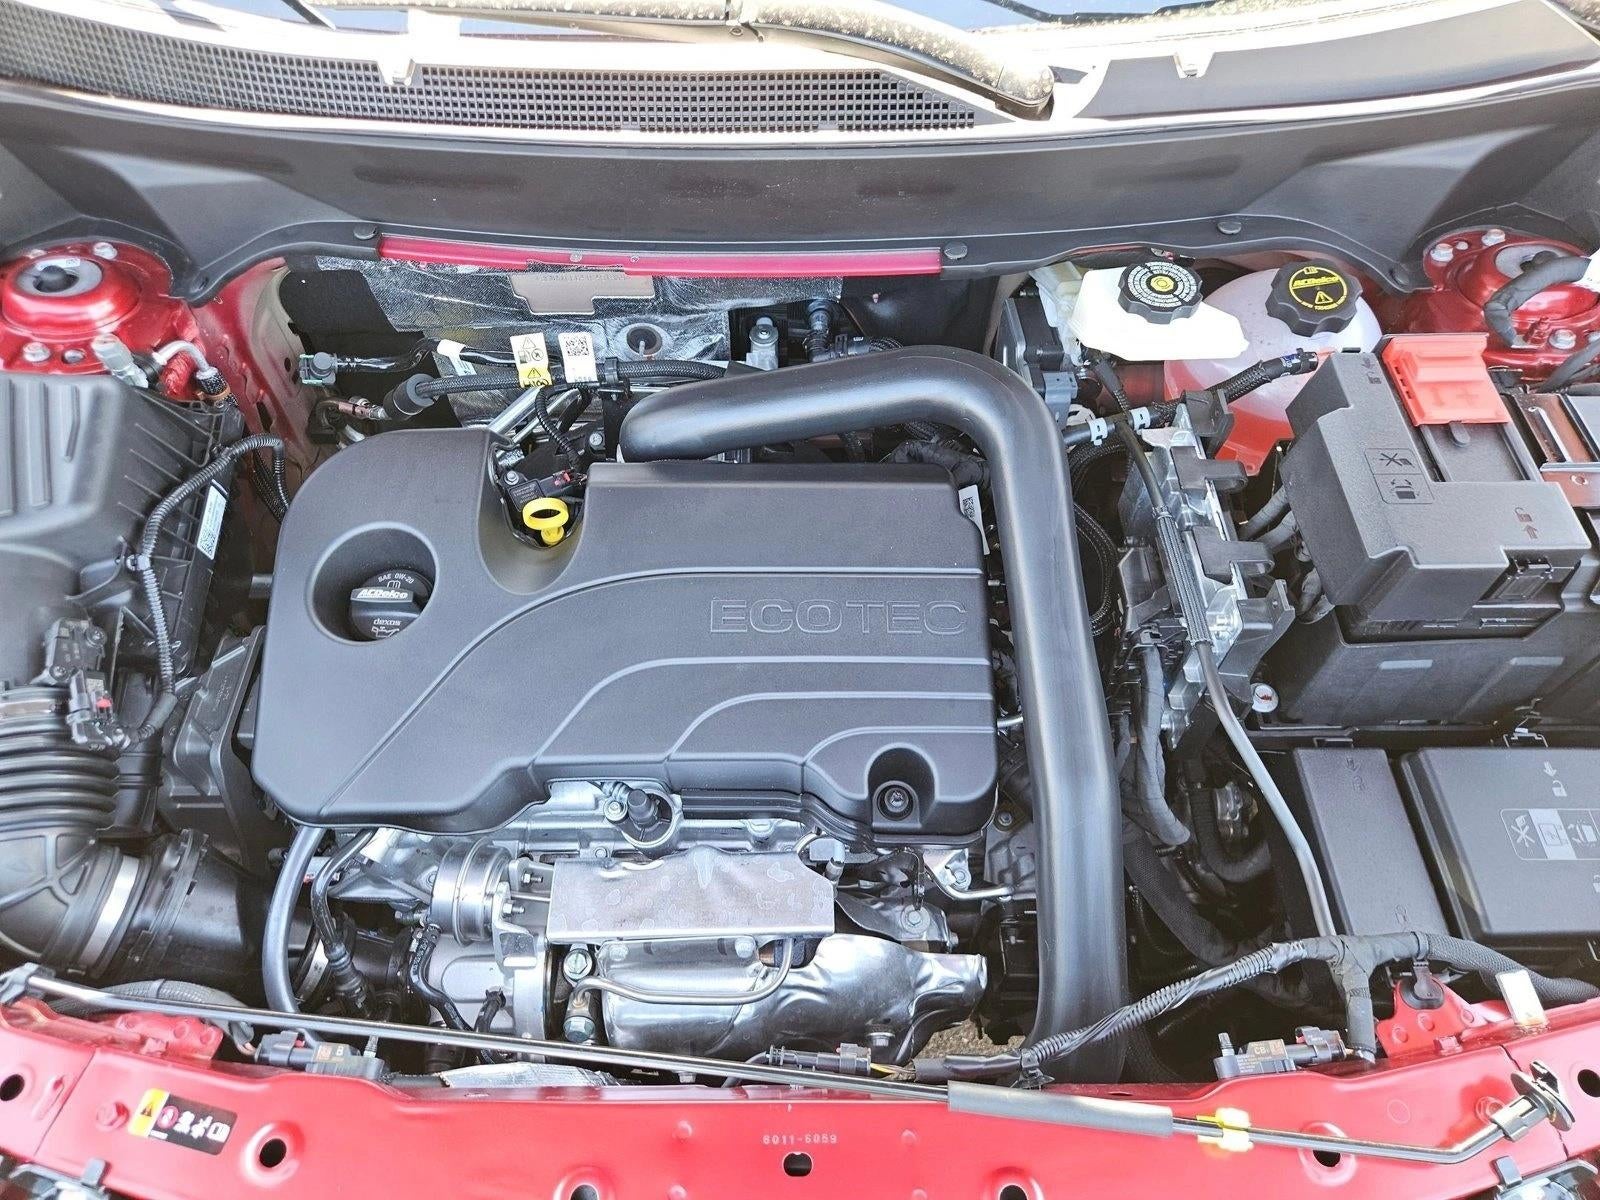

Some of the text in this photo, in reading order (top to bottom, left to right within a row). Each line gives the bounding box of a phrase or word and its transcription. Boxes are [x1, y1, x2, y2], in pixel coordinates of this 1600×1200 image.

[378, 572, 415, 584] SAE 0W-20
[356, 588, 409, 599] ACDelco
[373, 617, 402, 626] dexos
[710, 599, 967, 635] ECOTEC
